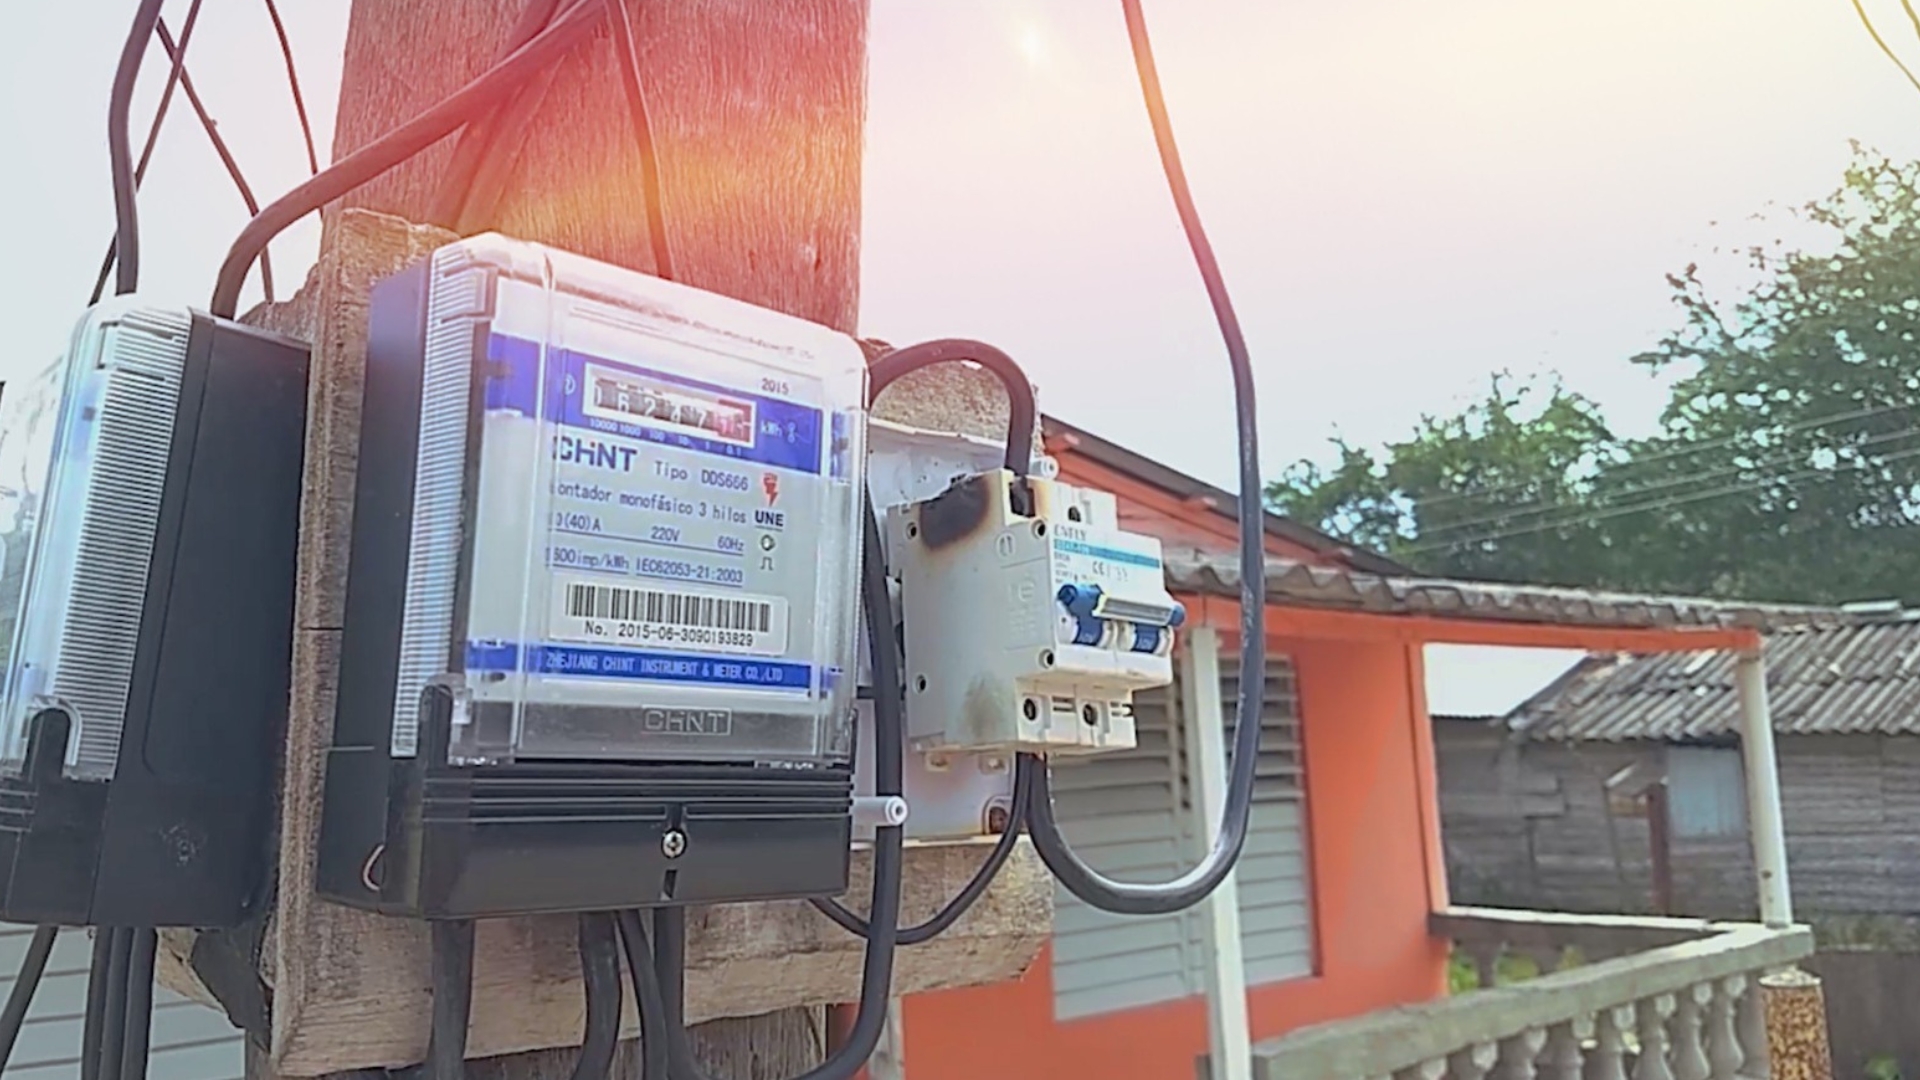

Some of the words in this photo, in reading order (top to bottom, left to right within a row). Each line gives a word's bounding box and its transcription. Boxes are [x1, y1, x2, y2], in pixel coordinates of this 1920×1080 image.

[762, 377, 789, 396] 2015
[655, 460, 688, 481] Tipo
[701, 469, 749, 492] DDS666
[549, 482, 612, 503] ontador
[619, 492, 693, 516] monofásico
[699, 502, 707, 517] 3
[712, 505, 746, 524] hilos
[754, 510, 784, 527] UNE
[651, 525, 681, 542] 220V
[717, 536, 744, 552] 60Hz
[635, 557, 743, 583] IEC62053-21:2003
[585, 620, 608, 637] No.
[618, 622, 753, 647] 2015-06-3090193829
[546, 651, 599, 671] ZHEJIANG
[602, 655, 635, 672] CHINT
[640, 658, 698, 677] INSTRUMENT
[701, 661, 710, 677] &
[713, 662, 742, 680] METER
